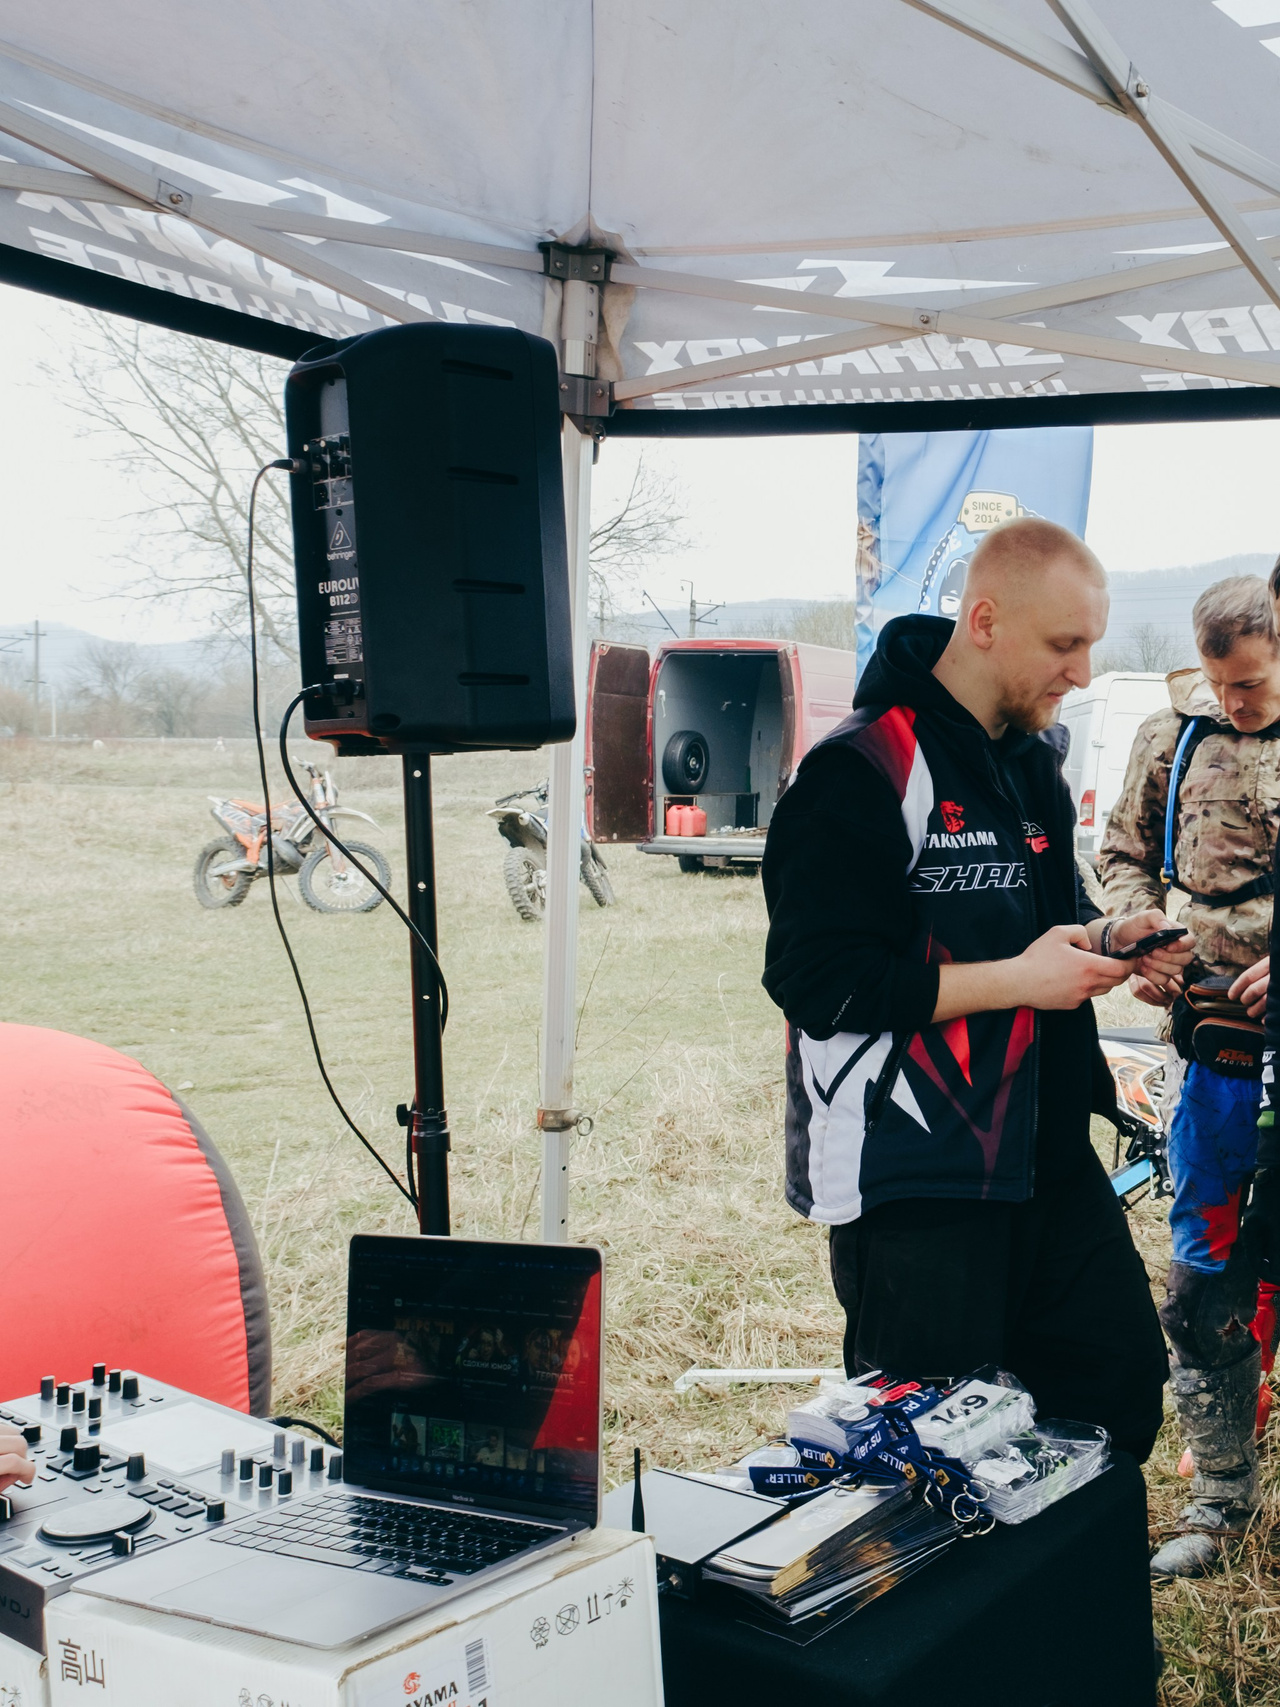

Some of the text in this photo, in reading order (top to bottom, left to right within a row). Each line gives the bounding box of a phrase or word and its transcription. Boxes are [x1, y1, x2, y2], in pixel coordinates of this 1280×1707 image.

[972, 501, 1002, 512] SINCE
[974, 514, 1000, 524] 2014
[329, 593, 358, 607] B112D
[924, 831, 998, 849] TAKAYAMA
[58, 1638, 105, 1688] 高山
[405, 1681, 459, 1707] YAMA
